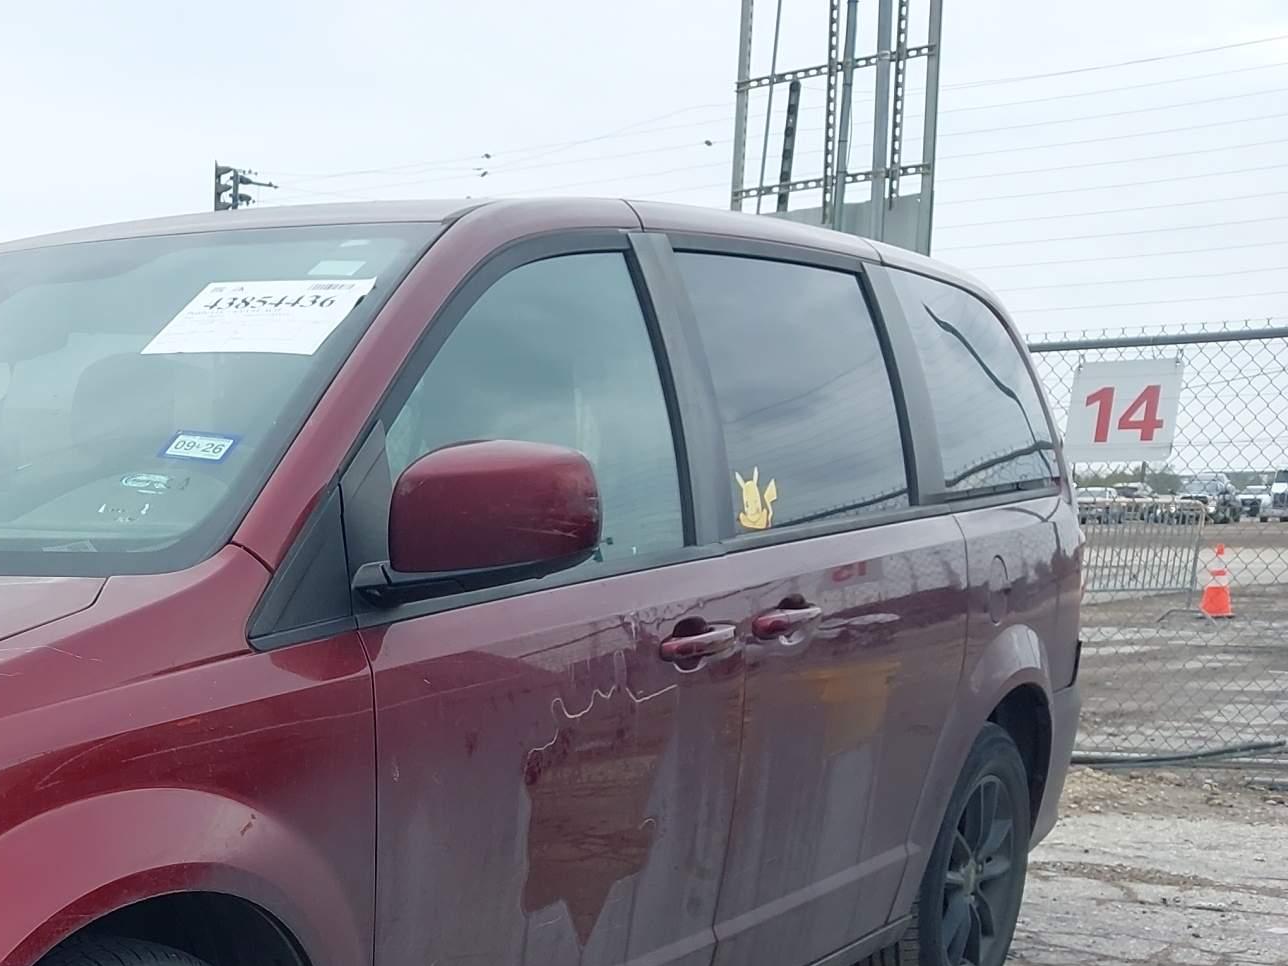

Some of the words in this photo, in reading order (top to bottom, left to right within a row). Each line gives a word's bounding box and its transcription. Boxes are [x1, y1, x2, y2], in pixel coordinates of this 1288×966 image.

[203, 294, 337, 310] 43854436
[1085, 384, 1165, 443] 14
[173, 439, 198, 451] 09
[201, 442, 226, 455] 26
